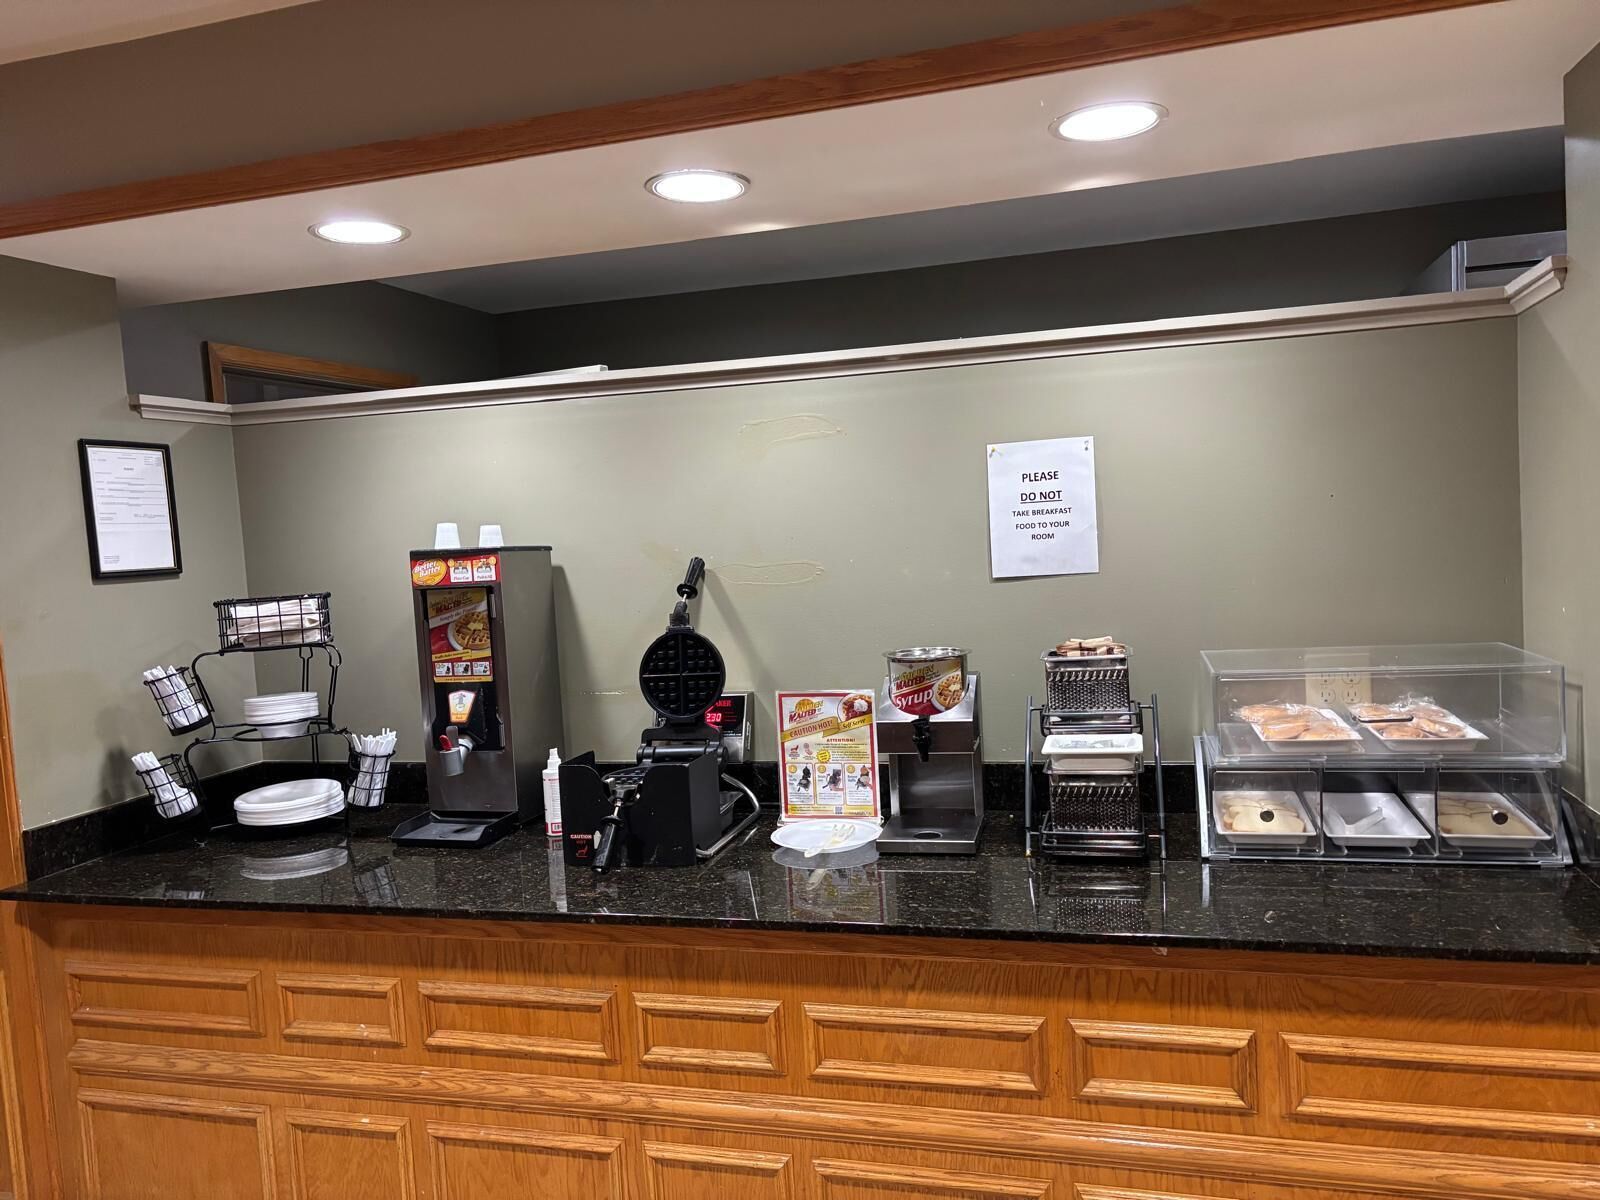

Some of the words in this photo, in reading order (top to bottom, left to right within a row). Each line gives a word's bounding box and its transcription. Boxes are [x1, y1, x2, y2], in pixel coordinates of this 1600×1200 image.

[1022, 471, 1059, 482] PLEASE
[1020, 492, 1036, 502] DO
[1040, 491, 1062, 501] NOT
[1032, 507, 1072, 516] BREAKFAST
[414, 560, 437, 573] Better
[419, 566, 441, 578] Batter
[895, 676, 925, 690] MALTED
[896, 689, 933, 709] Syrup
[788, 708, 817, 724] MALTED
[789, 724, 818, 738] CAUTION
[818, 720, 833, 730] HOT!
[842, 721, 852, 729] Self
[852, 718, 866, 726] Serve
